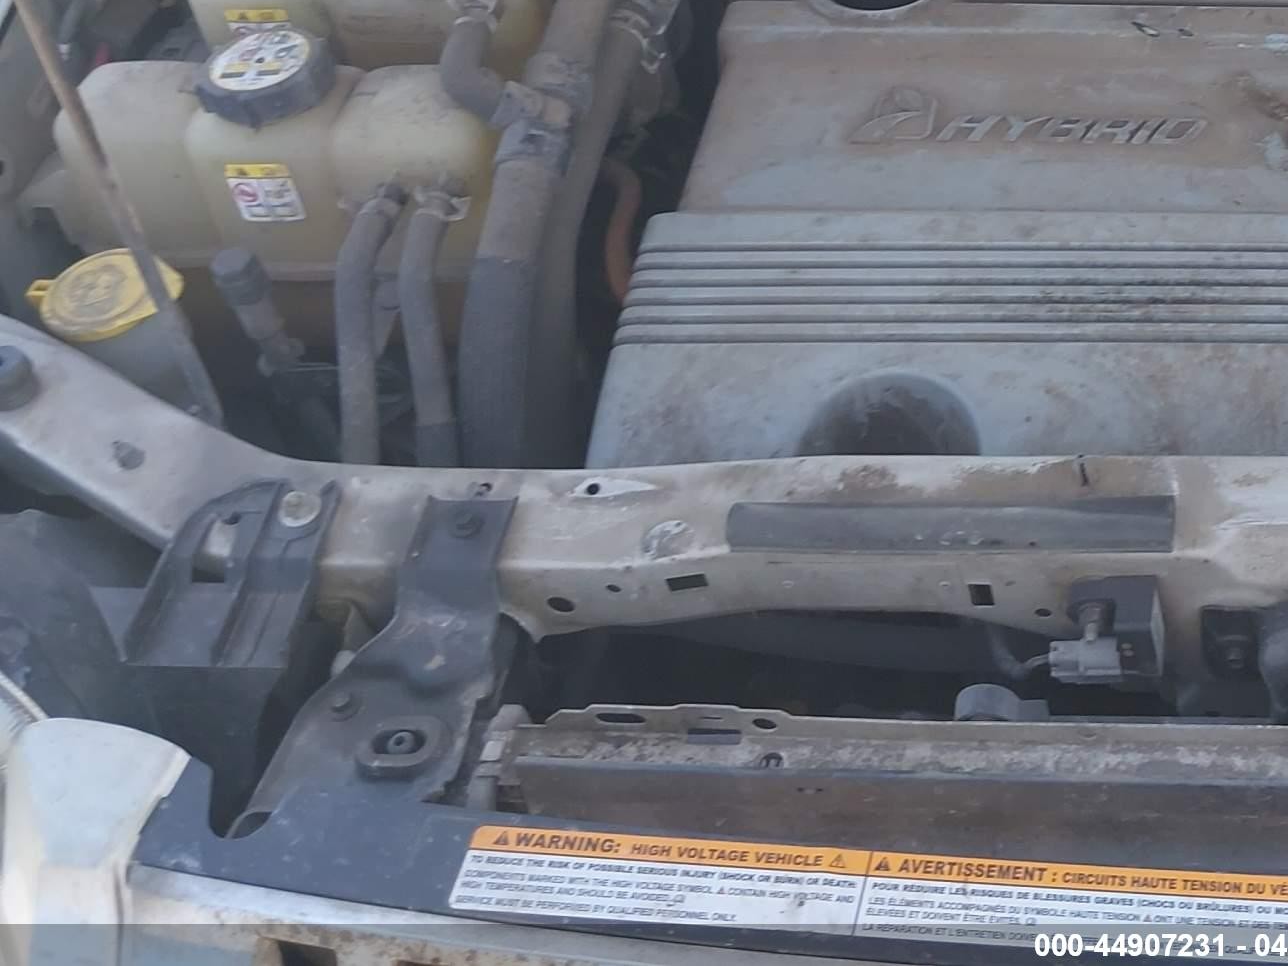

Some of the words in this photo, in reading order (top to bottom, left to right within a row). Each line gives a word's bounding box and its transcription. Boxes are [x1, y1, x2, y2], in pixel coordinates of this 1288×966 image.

[936, 115, 1207, 144] HYBRID
[515, 833, 621, 853] WARNING:
[630, 842, 673, 857] HIGH
[677, 846, 751, 862] VOLTAGE
[754, 851, 824, 867] VEHICLE
[470, 854, 483, 863] TO
[485, 855, 523, 866] REDUCE
[526, 858, 545, 867] THE
[548, 859, 570, 869] RISK
[573, 861, 587, 870] OF
[588, 862, 633, 873] POSSIBLE
[637, 866, 678, 877] SERIOUS
[680, 868, 716, 879] INJURY
[717, 870, 753, 881] (SHOCK
[757, 873, 770, 882] OR
[774, 874, 803, 884] BURN)
[806, 876, 819, 885] OR
[898, 858, 1047, 882] AVERTISSEMENT
[1062, 872, 1126, 886] CIRCUITS
[1131, 876, 1177, 889] HAUTE
[1182, 879, 1241, 893] TENSION
[1246, 883, 1265, 894] DU
